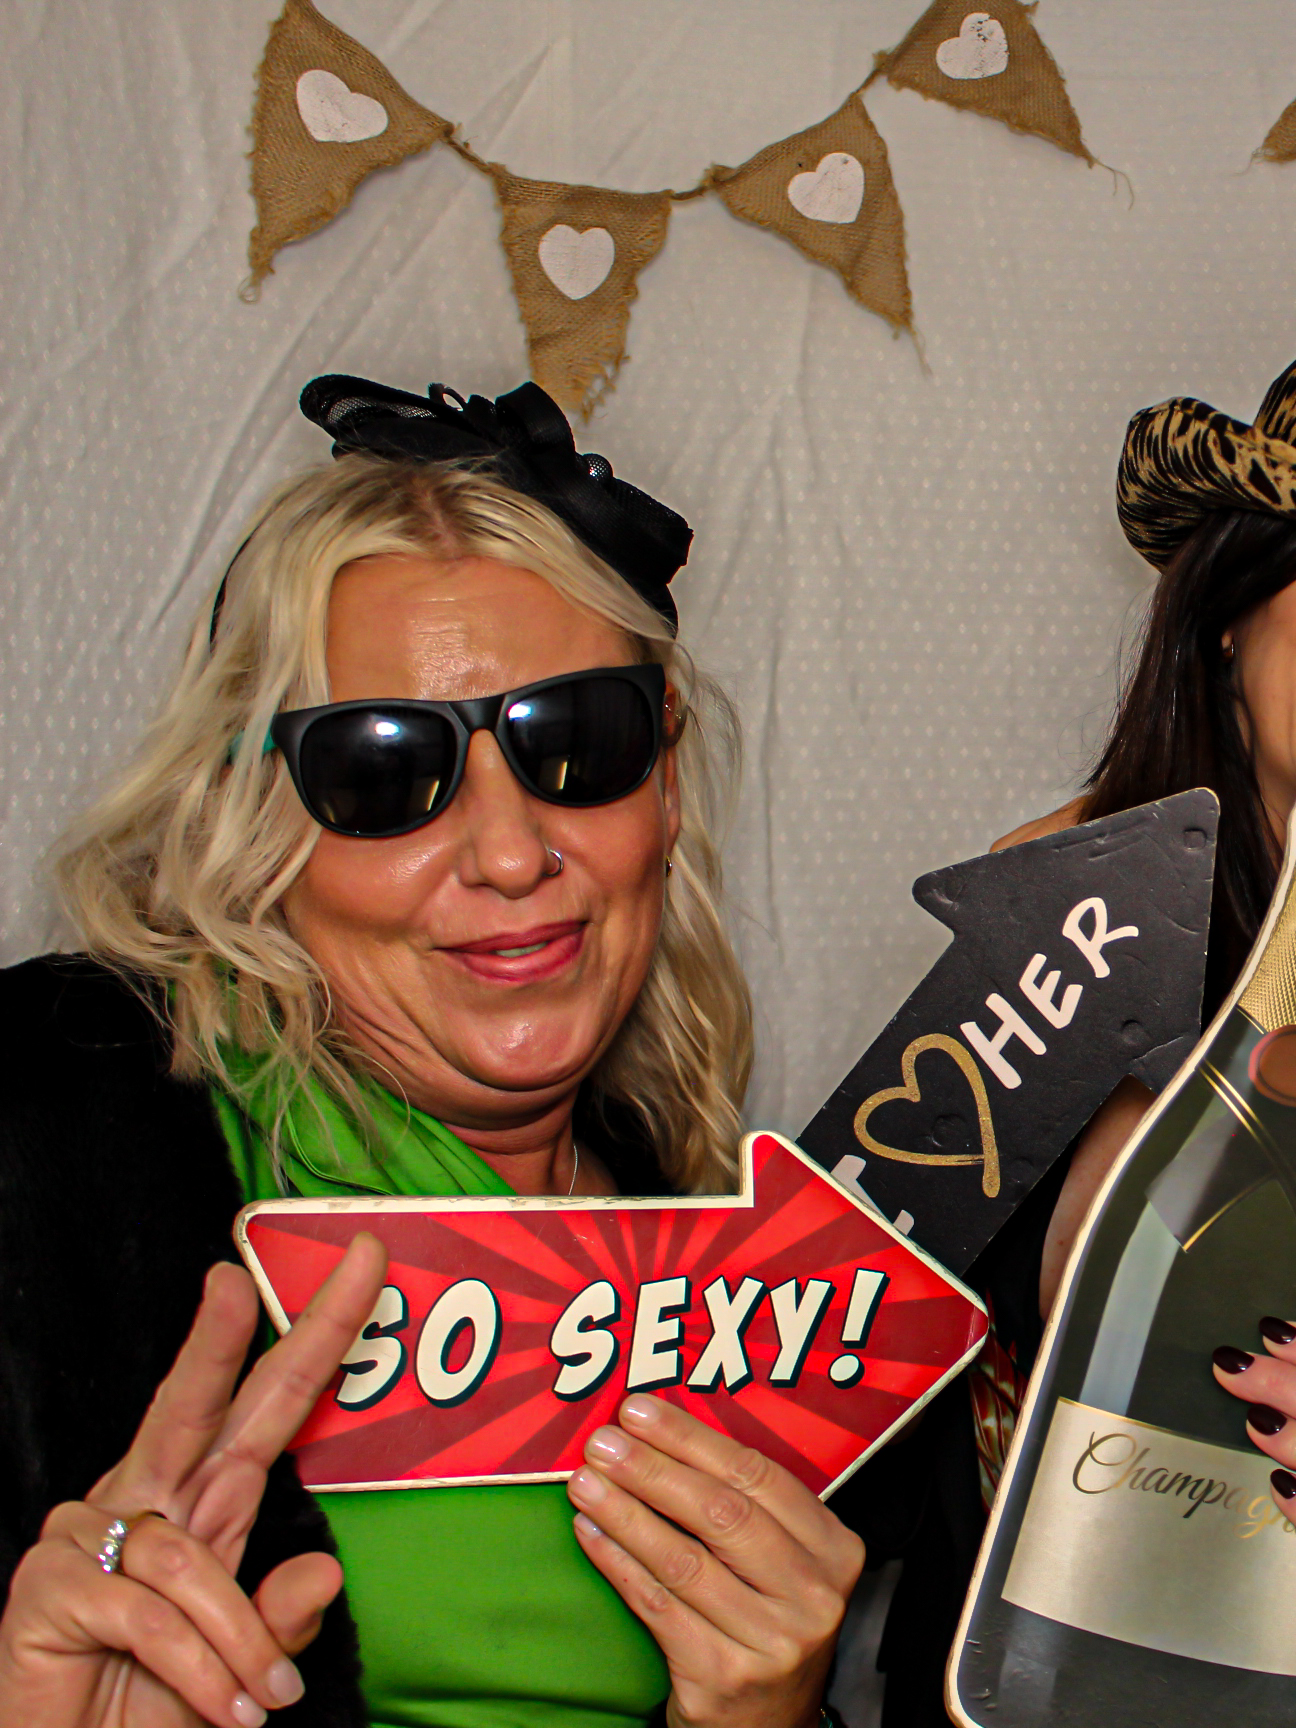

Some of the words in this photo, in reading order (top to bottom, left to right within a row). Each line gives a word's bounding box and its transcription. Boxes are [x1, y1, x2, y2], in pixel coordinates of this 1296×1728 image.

[960, 897, 1139, 1090] HER
[334, 1278, 502, 1411] SO
[549, 1268, 887, 1403] SEXY!
